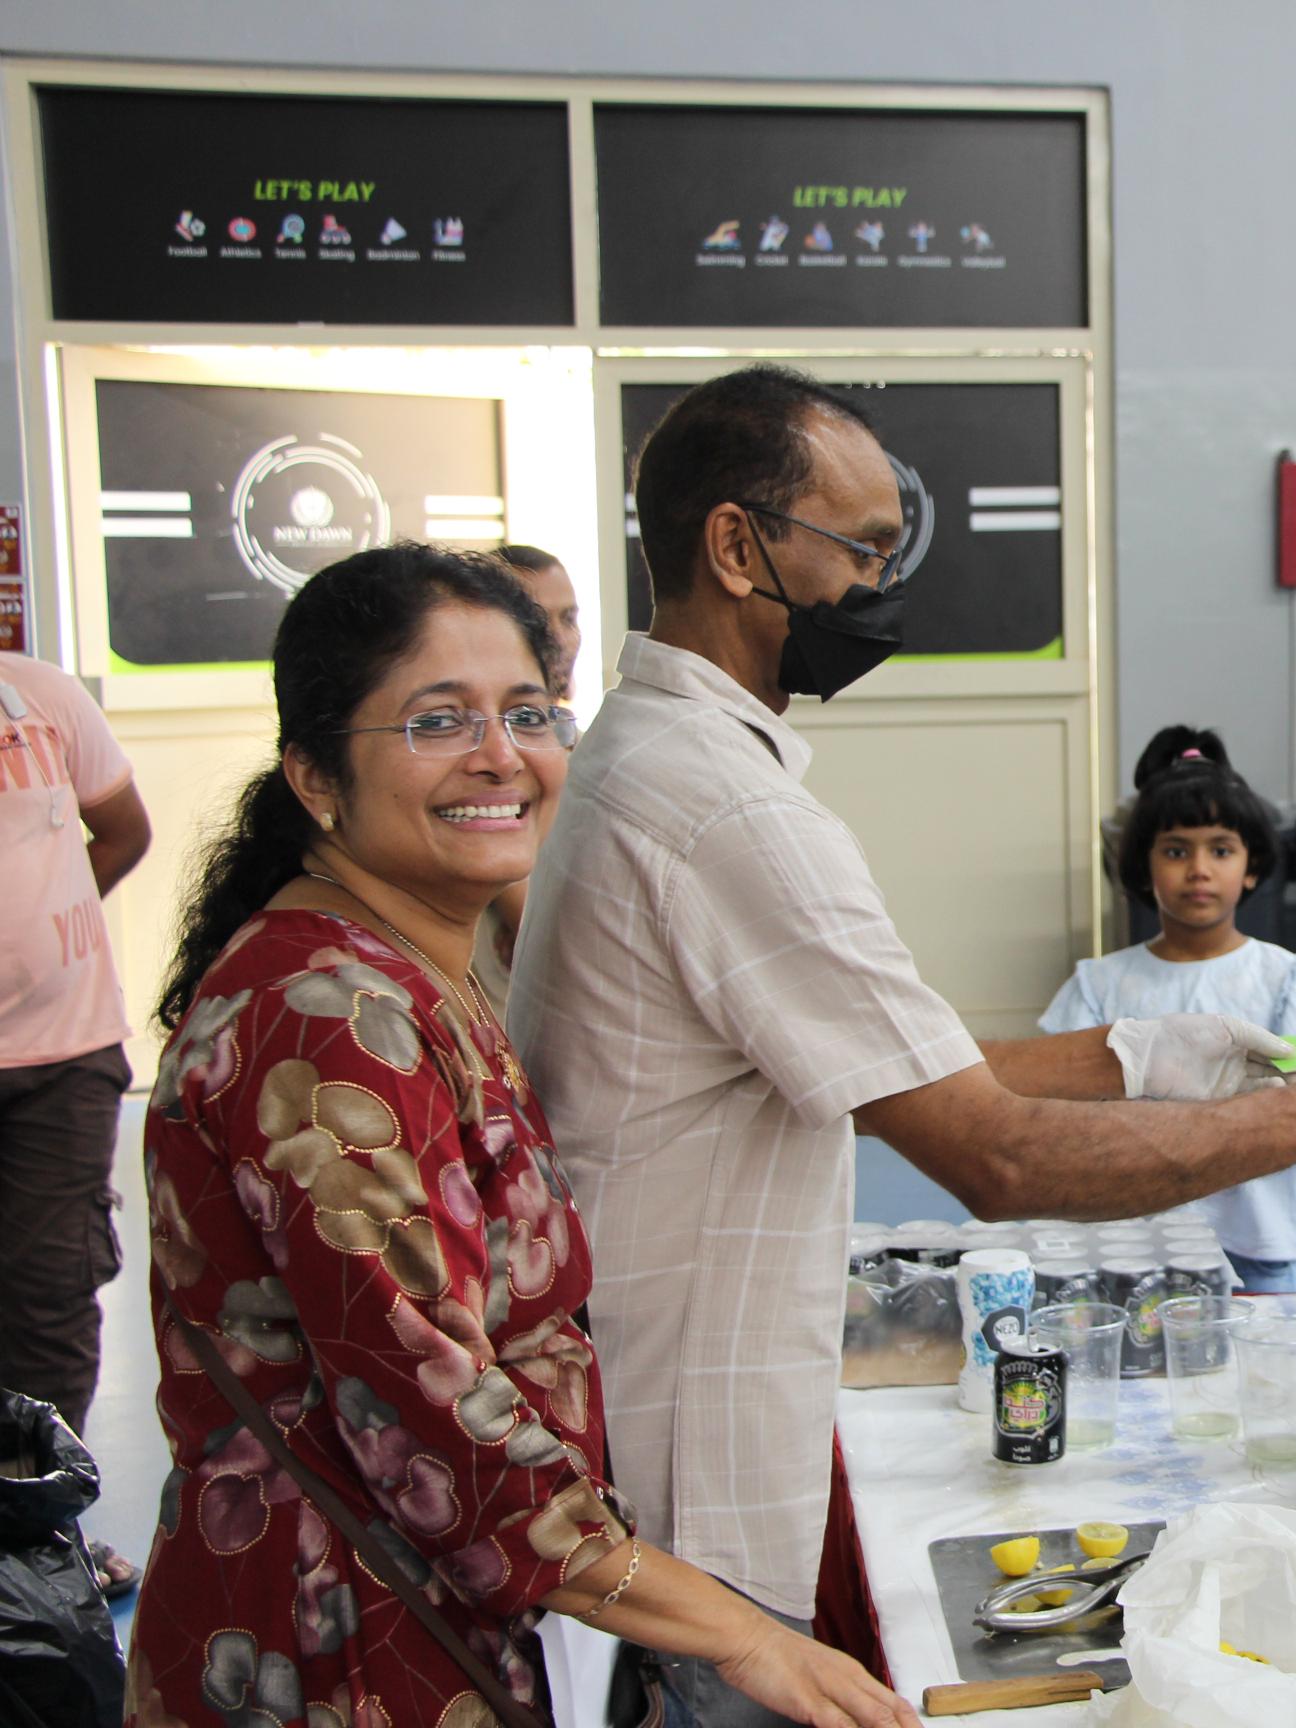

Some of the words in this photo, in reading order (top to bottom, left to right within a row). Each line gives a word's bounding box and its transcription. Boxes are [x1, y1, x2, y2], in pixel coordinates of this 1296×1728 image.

[254, 180, 311, 200] LET'S
[318, 181, 375, 202] PLAY
[795, 187, 848, 207] LET'S
[853, 188, 907, 207] PLAY
[168, 246, 207, 258] Football
[220, 247, 261, 259] Athletics
[273, 525, 307, 542] NEW
[308, 526, 352, 542] DAWN
[52, 895, 102, 968] YOU
